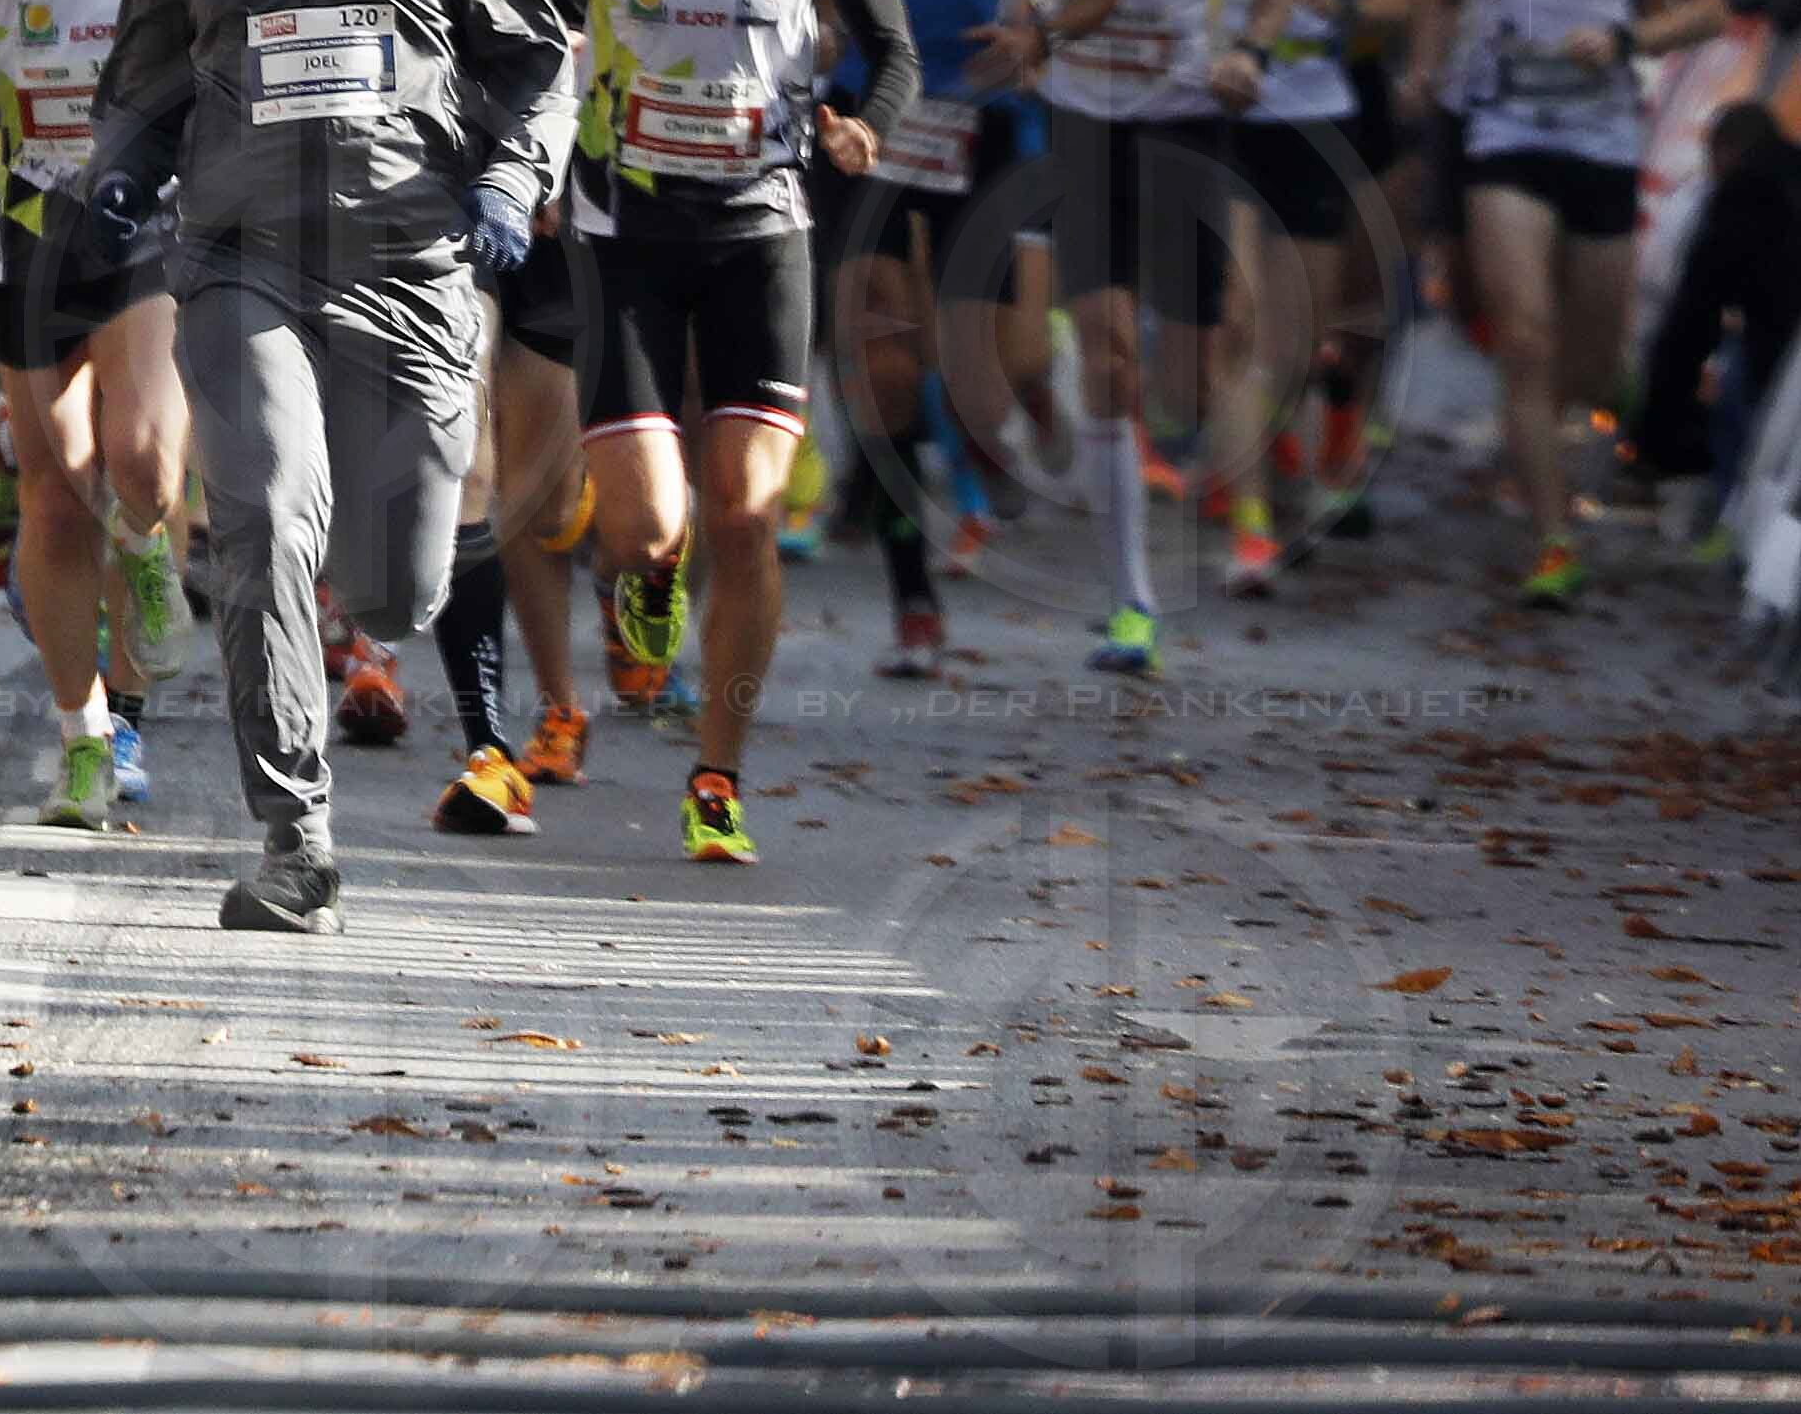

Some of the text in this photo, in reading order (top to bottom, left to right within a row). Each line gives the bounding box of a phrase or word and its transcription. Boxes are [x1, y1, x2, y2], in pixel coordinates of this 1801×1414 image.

[339, 8, 379, 27] 120
[674, 9, 728, 27] EJOT
[303, 53, 341, 72] JOEL
